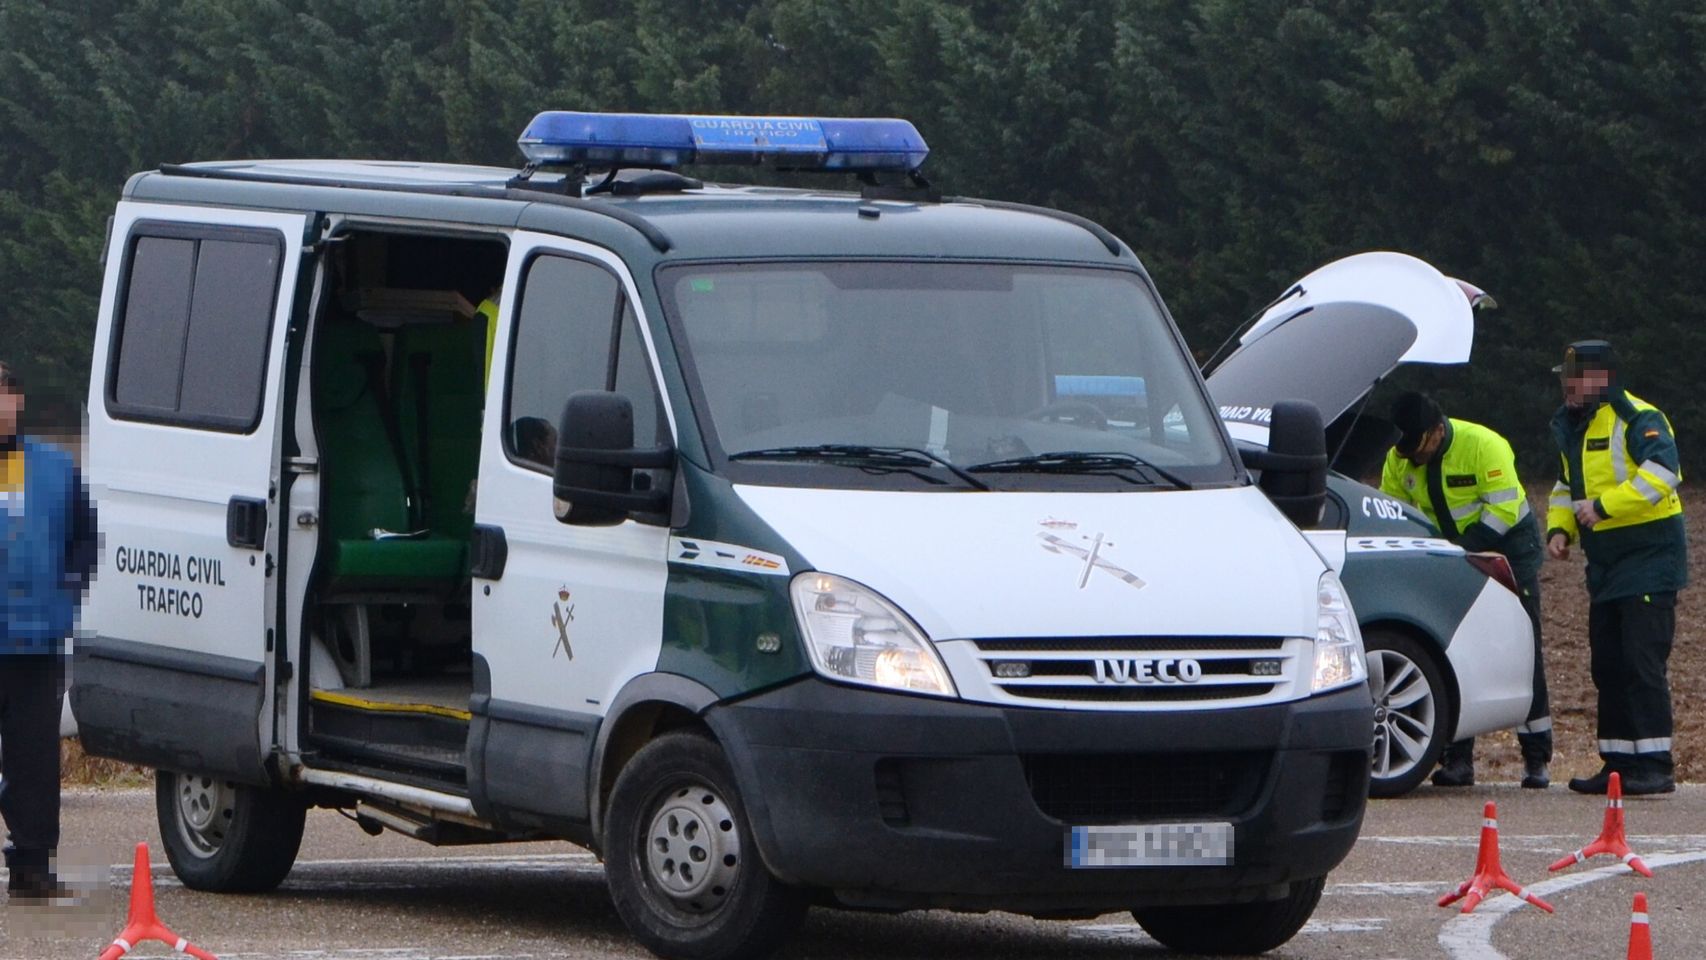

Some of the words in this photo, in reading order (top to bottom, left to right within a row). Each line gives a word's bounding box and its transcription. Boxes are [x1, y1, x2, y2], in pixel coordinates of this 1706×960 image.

[693, 120, 774, 130] GUARDIA
[777, 121, 818, 131] CIVIL
[1373, 497, 1408, 520] 062
[116, 546, 181, 580] GUARDIA
[187, 556, 225, 586] CIVIL
[137, 584, 203, 618] TRAFICO
[1094, 658, 1202, 683] IVECO
